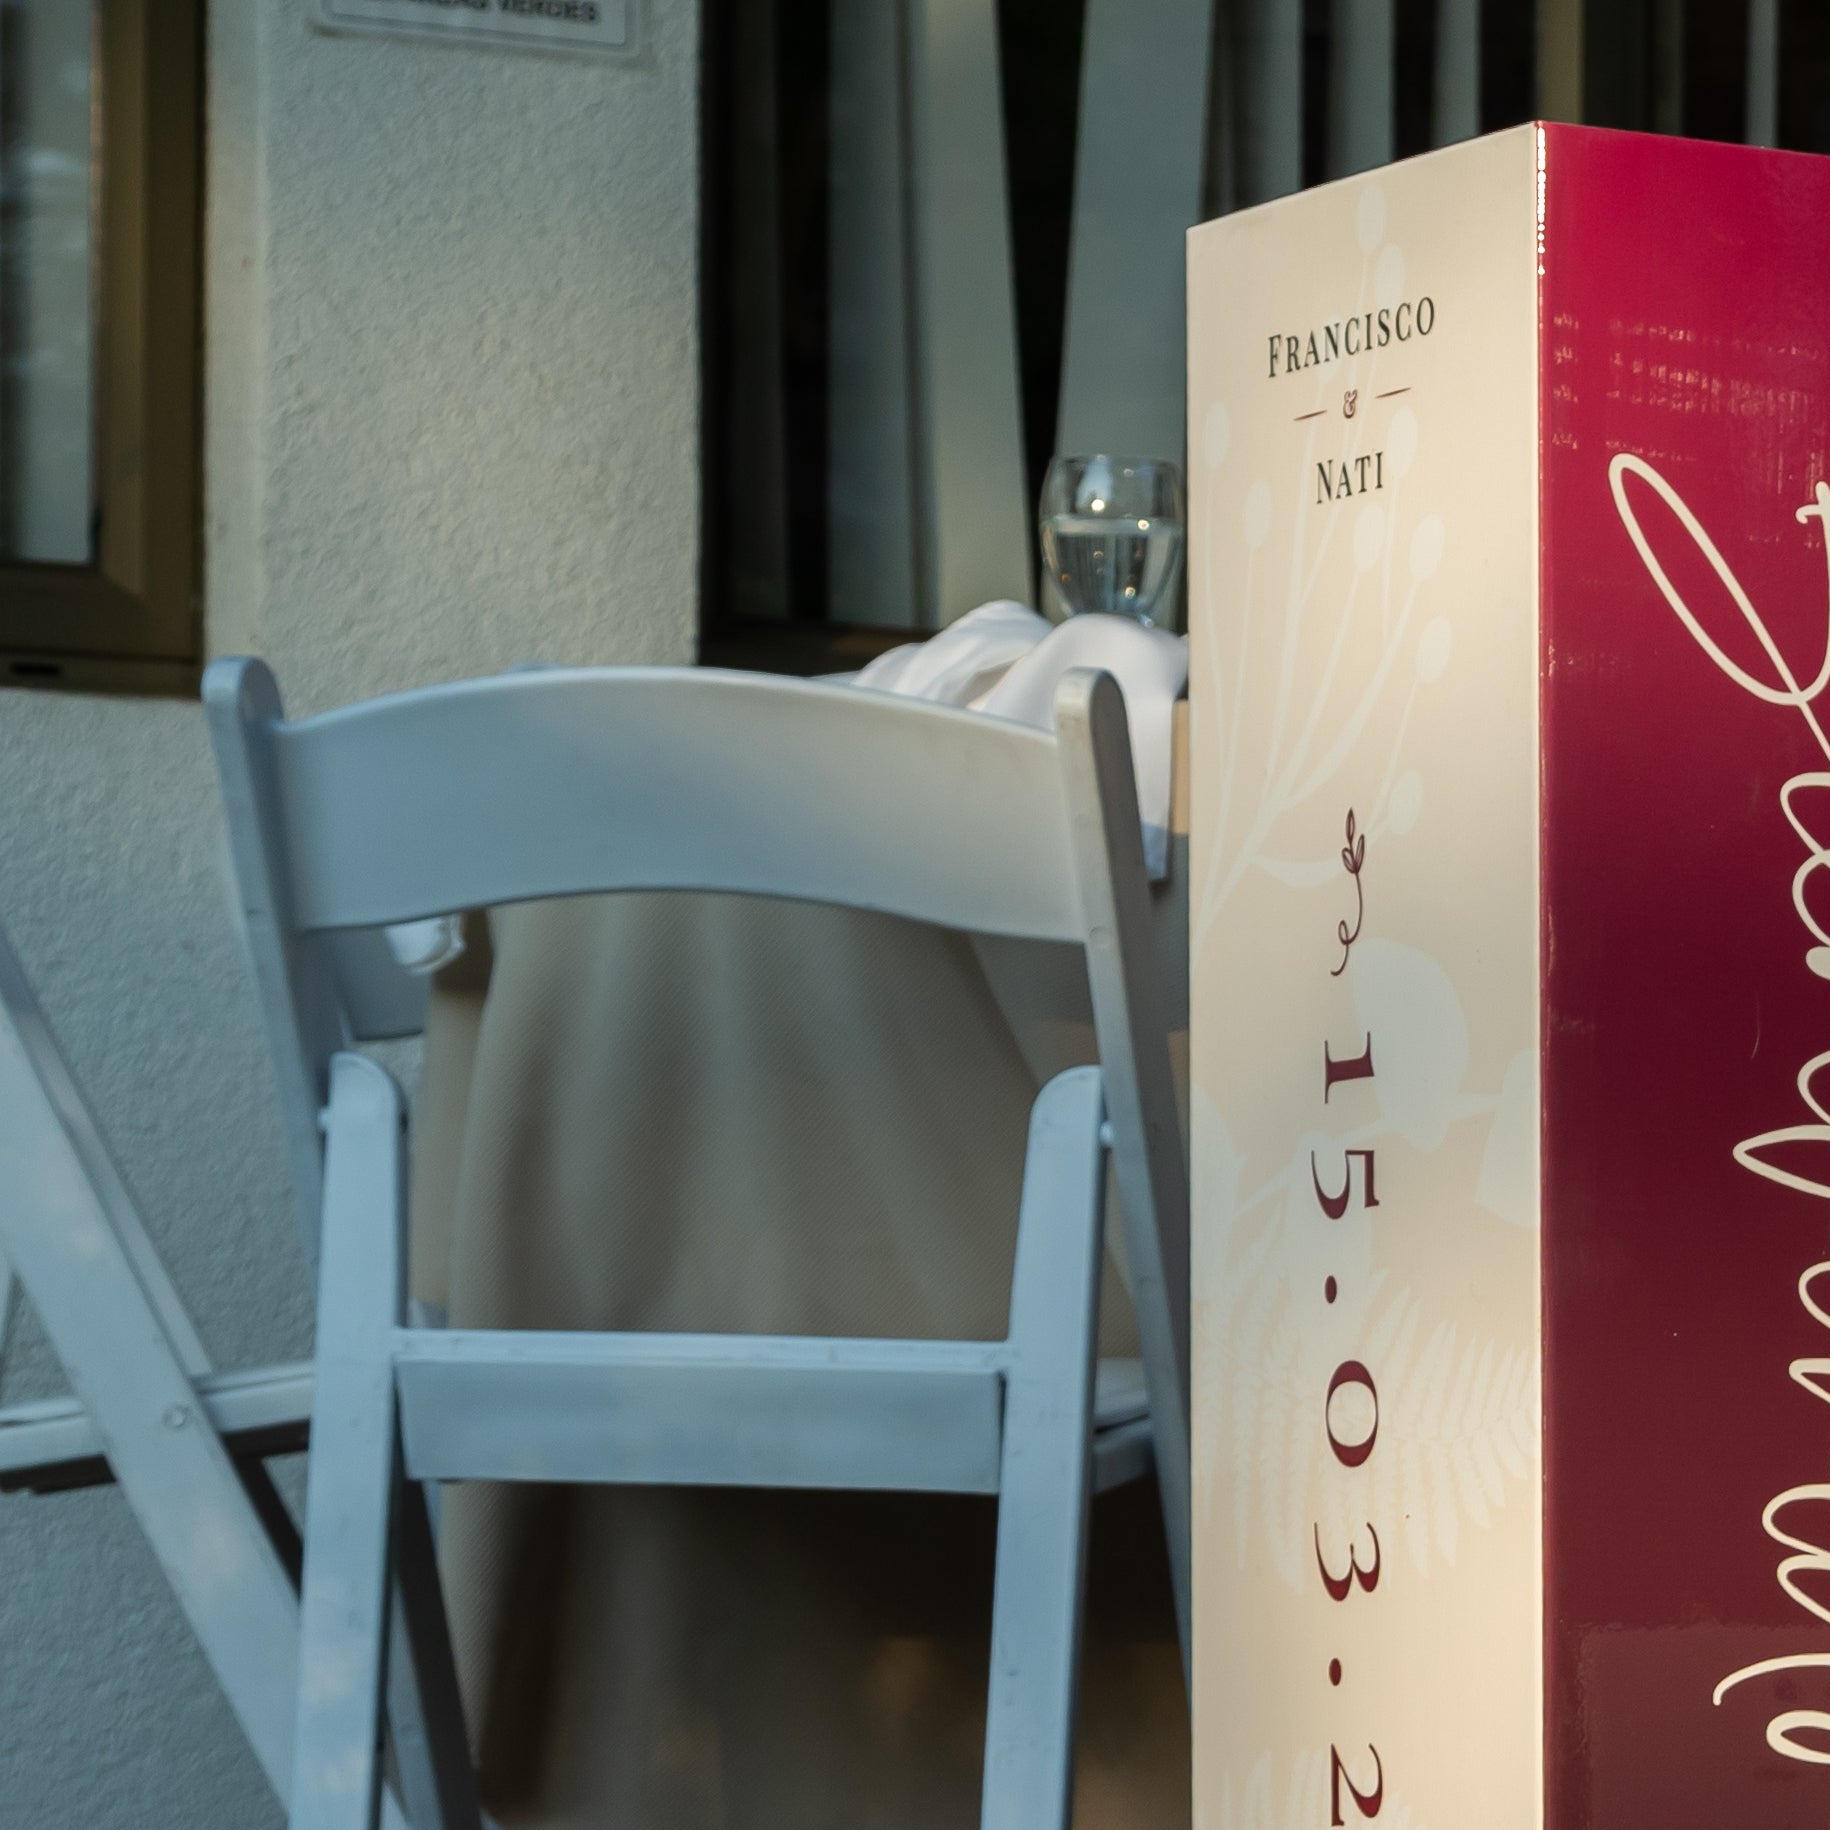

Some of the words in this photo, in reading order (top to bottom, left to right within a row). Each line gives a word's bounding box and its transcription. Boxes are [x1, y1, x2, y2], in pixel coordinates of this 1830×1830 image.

[1268, 296, 1435, 378] FRANCISCO
[1342, 389, 1358, 420] &
[1316, 451, 1383, 505] NATI
